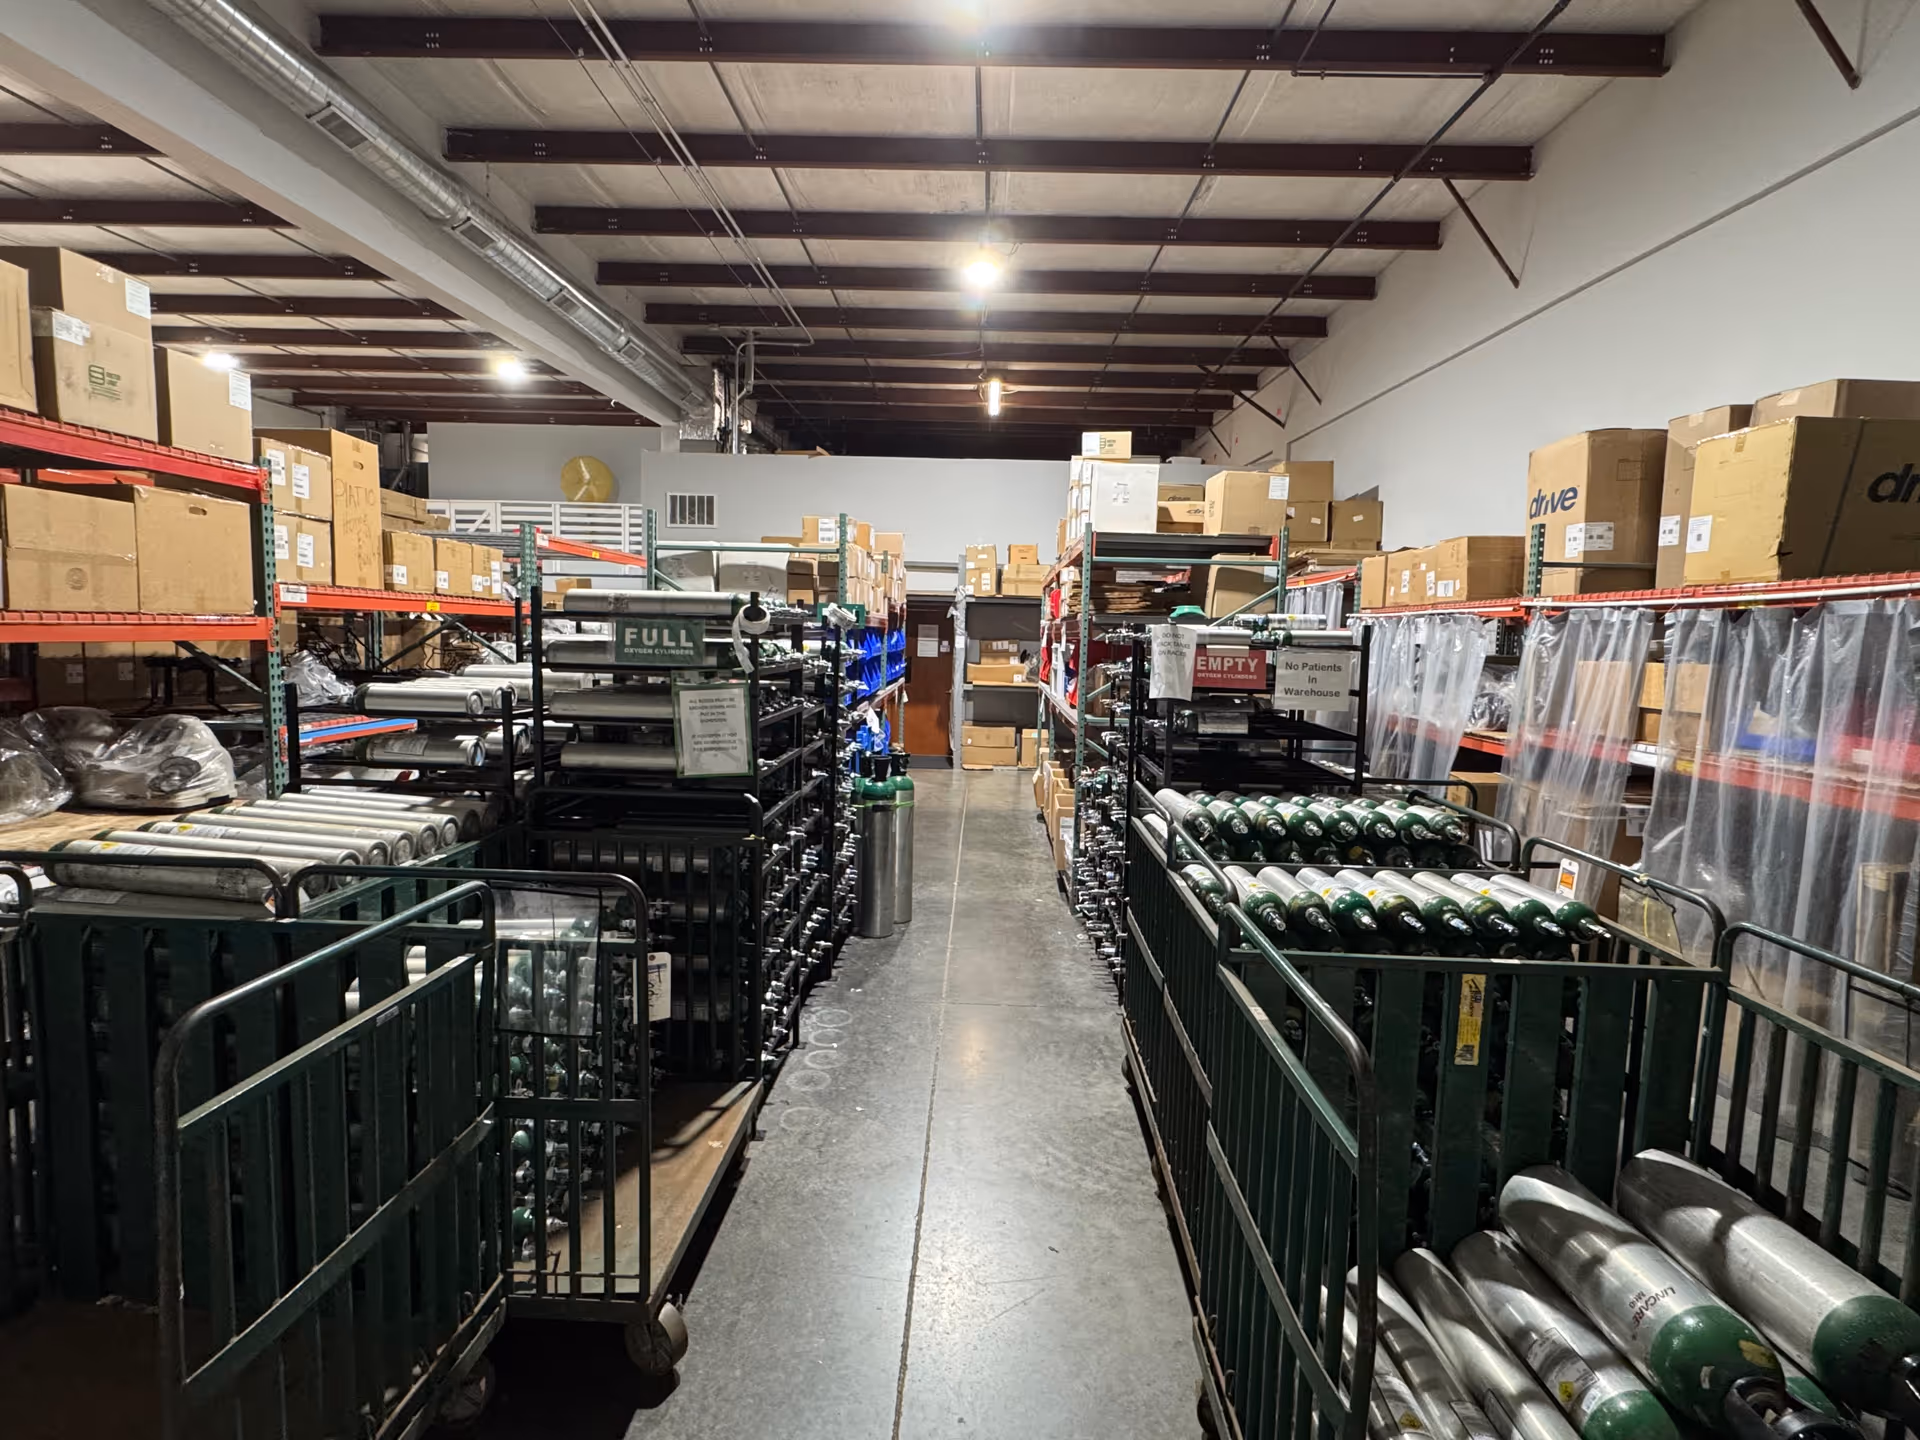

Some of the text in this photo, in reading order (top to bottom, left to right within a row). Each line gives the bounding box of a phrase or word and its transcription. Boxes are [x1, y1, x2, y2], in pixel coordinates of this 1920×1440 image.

[1868, 463, 1920, 503] dr
[1529, 487, 1578, 519] drive
[624, 627, 694, 647] FULL
[1196, 656, 1258, 672] EMPTY
[1284, 661, 1342, 672] No Patients
[1284, 687, 1341, 697] Warehouse
[1632, 1287, 1676, 1328] LINCARE
